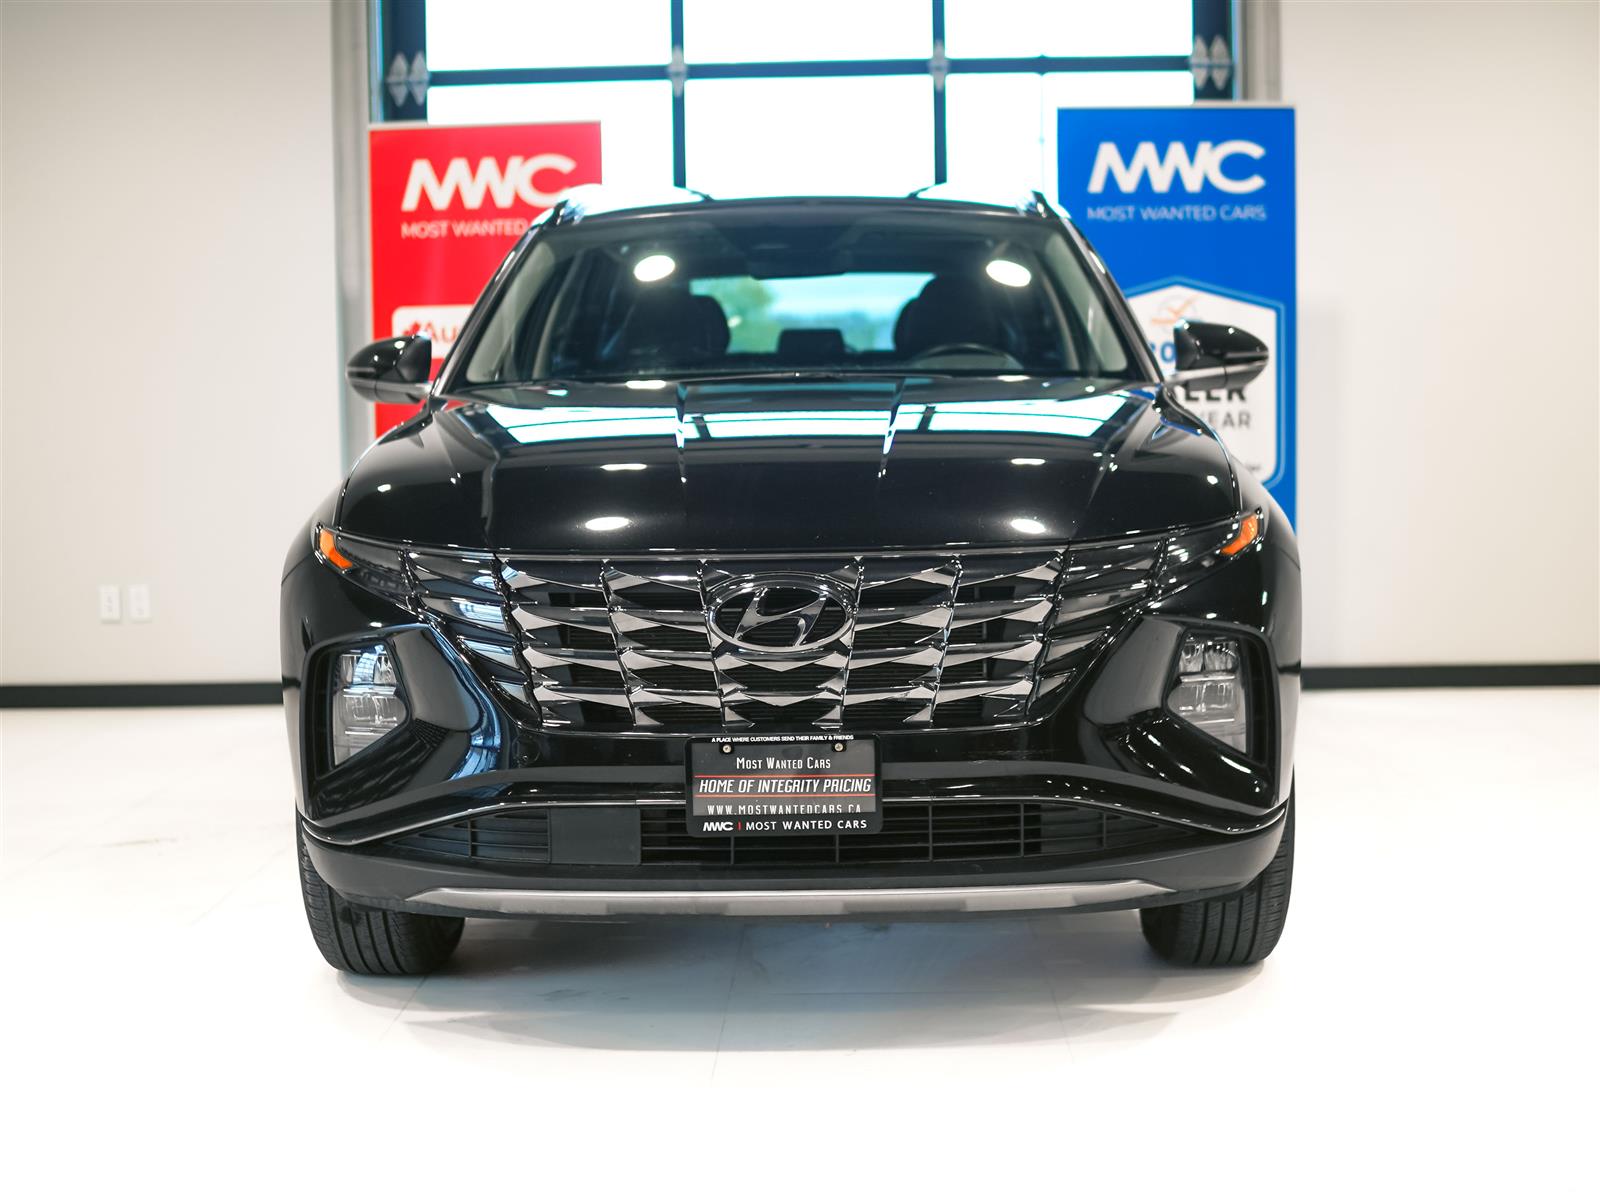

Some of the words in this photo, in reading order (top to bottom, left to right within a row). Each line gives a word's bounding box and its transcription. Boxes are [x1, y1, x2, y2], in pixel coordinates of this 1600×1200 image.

[1087, 139, 1266, 194] MWC
[401, 153, 577, 212] MWC
[1087, 205, 1136, 221] MOST
[1140, 205, 1217, 221] WANTED
[1219, 204, 1267, 221] CARS
[401, 220, 450, 239] MOST
[451, 217, 529, 237] WANTED
[699, 779, 735, 793] HOME
[737, 779, 755, 793] OF
[757, 779, 820, 793] INTEGRITY
[822, 778, 872, 792] PRICING
[745, 821, 777, 831] MOST
[782, 820, 832, 830] WANTED
[837, 819, 867, 829] CARS
